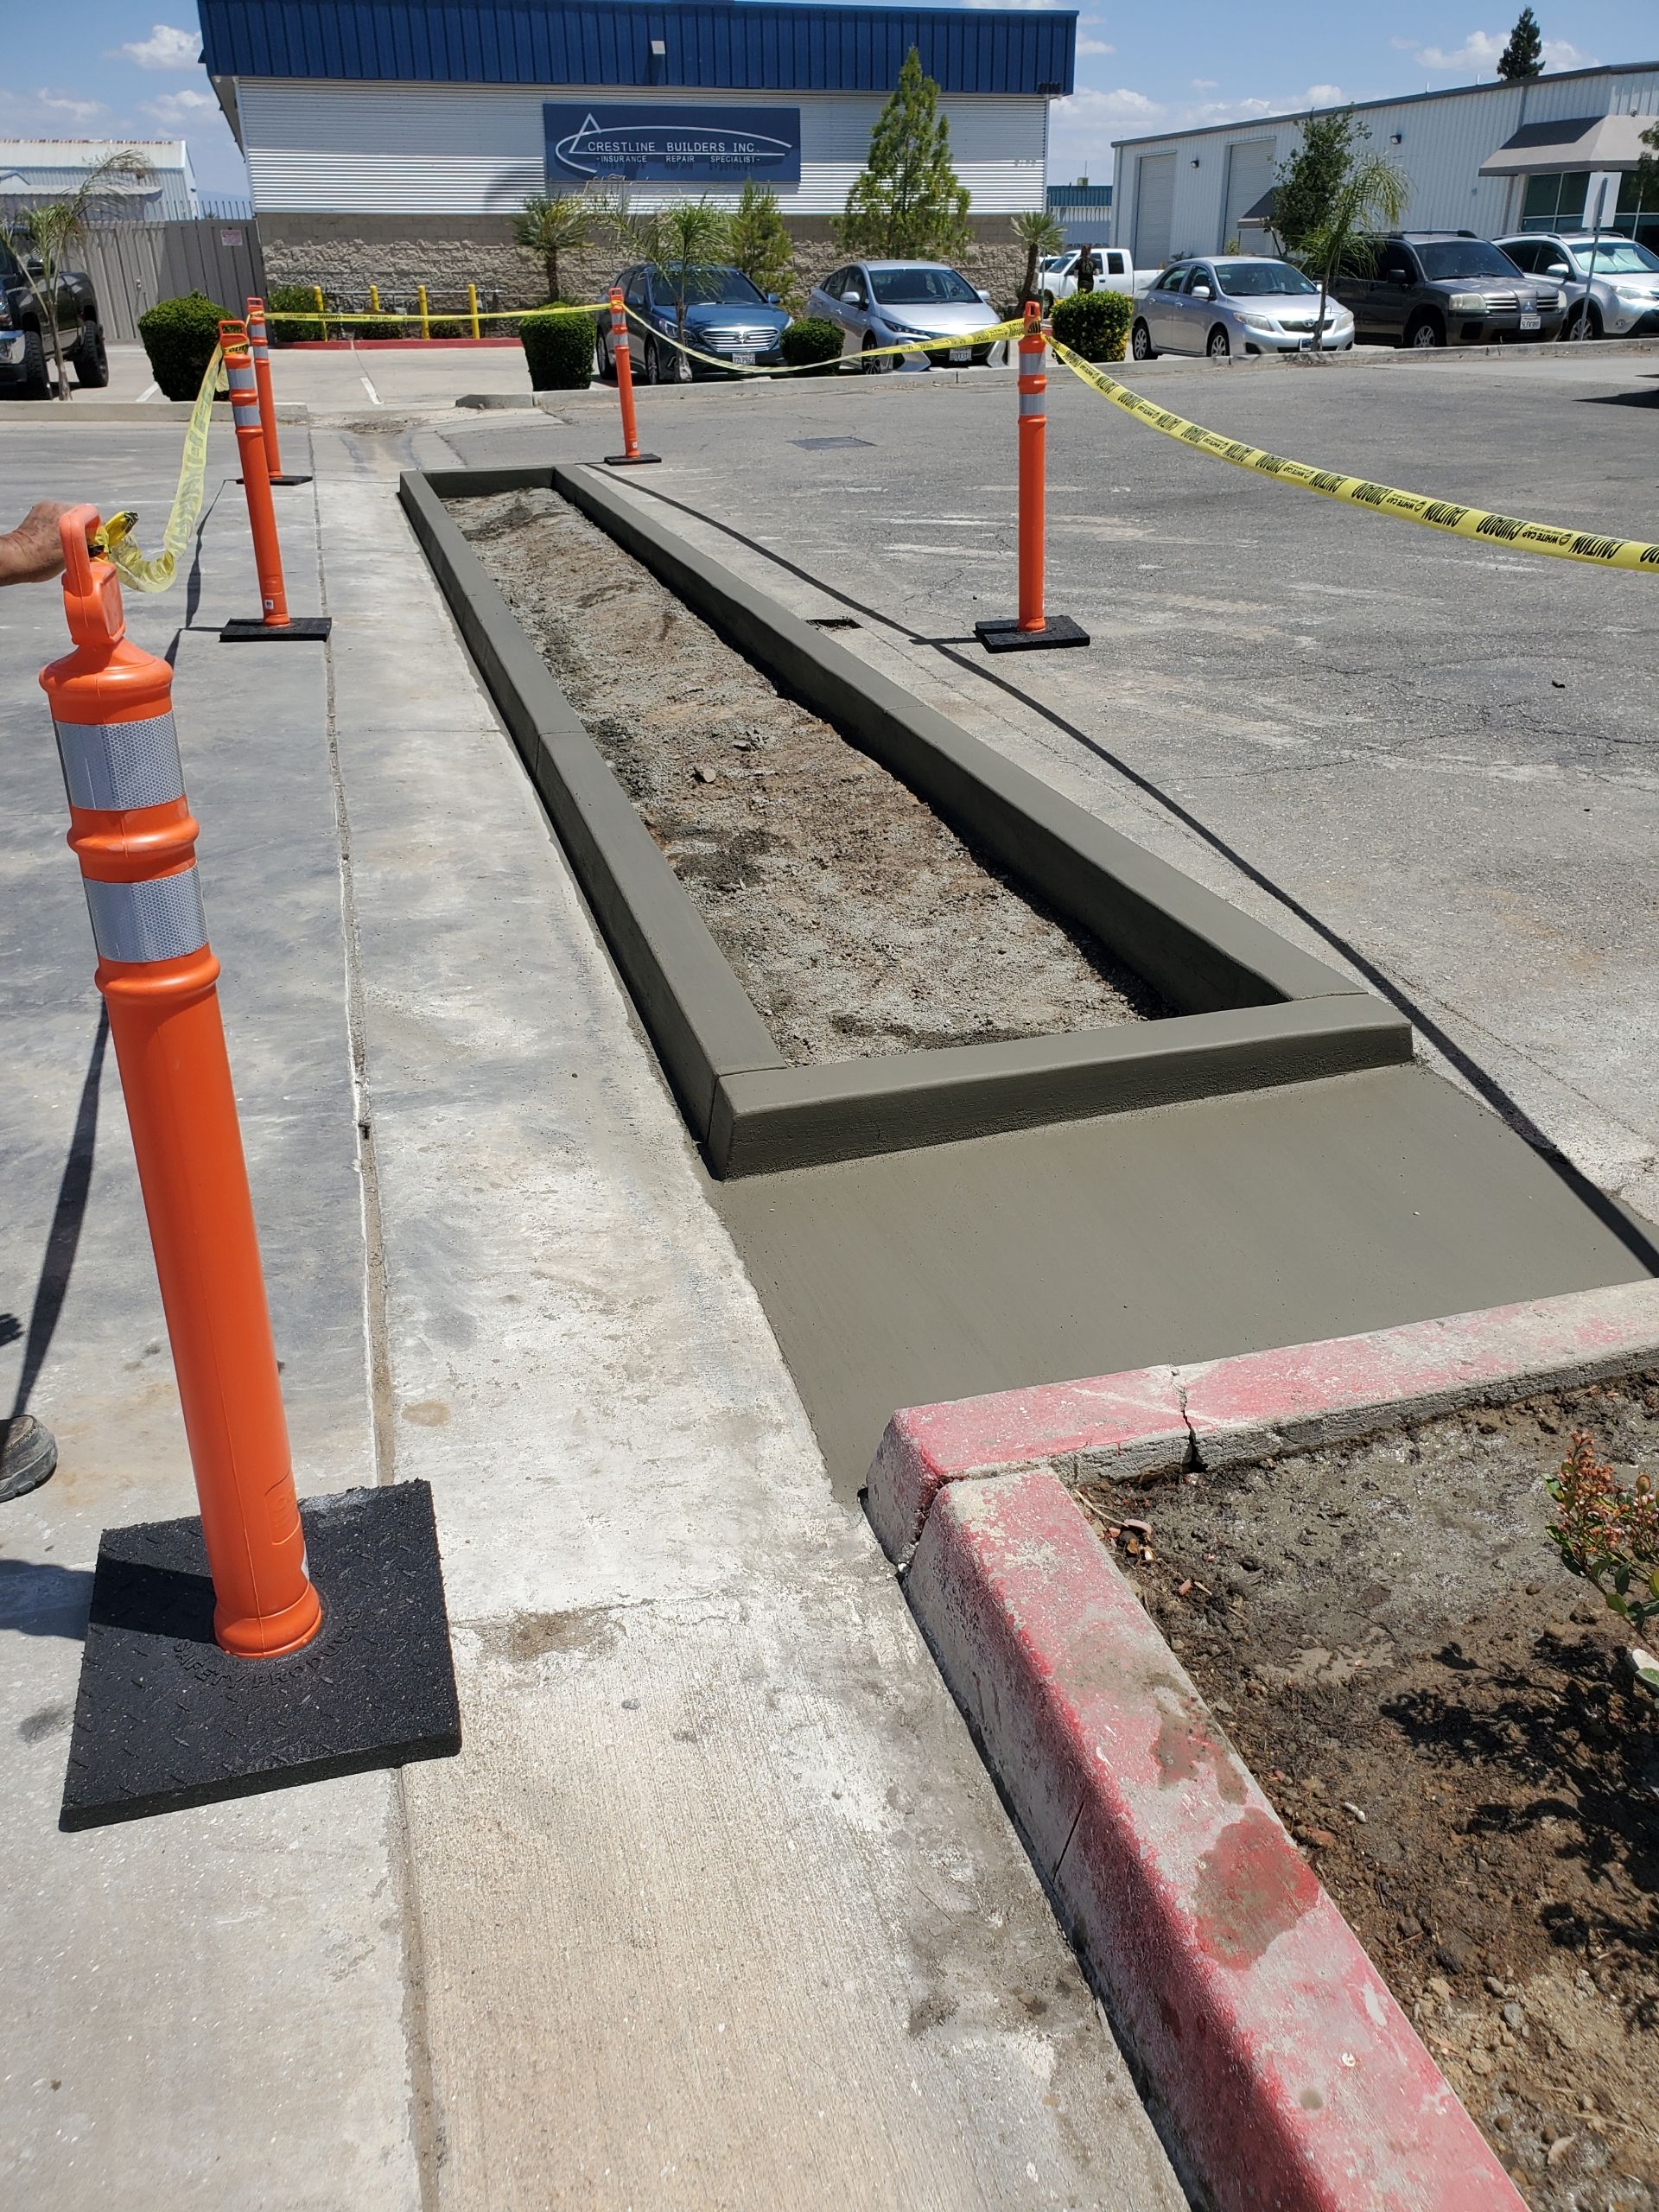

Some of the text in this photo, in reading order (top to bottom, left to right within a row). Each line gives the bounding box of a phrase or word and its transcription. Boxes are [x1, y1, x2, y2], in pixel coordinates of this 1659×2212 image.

[588, 141, 656, 153] CRESTLINE
[666, 143, 726, 153] BUILDERS
[1255, 454, 1288, 474] CUIDADO
[1308, 472, 1347, 493] CAUTION
[1351, 483, 1394, 505] CUIDADO
[1386, 497, 1397, 506] CAP
[1396, 499, 1415, 511] WHITE
[1421, 502, 1469, 527] CAUTION
[1476, 514, 1529, 540] CUIDADO
[1522, 530, 1535, 539] CAP
[1535, 533, 1559, 544] WHITE
[1568, 534, 1629, 559] CAUTION
